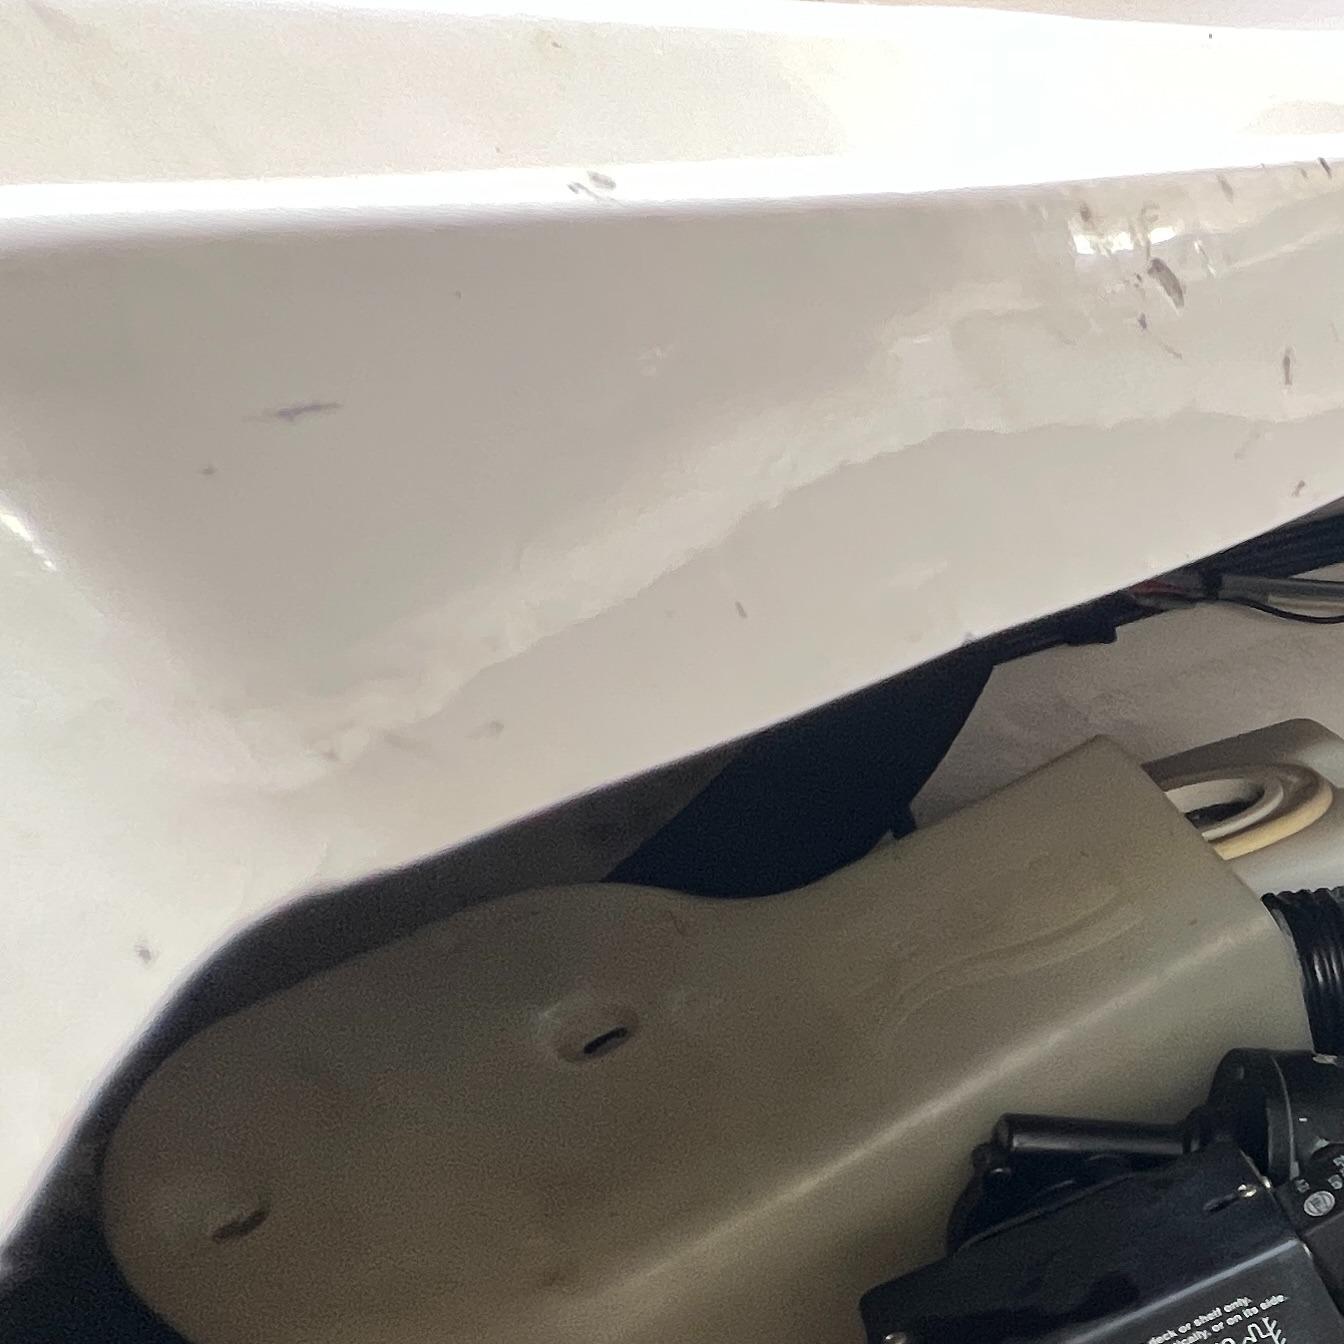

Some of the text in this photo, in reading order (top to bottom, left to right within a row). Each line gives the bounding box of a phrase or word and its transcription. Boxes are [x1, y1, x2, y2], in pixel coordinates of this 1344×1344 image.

[1178, 1323, 1191, 1333] or
[1211, 1321, 1224, 1332] or
[1226, 1314, 1243, 1325] on
